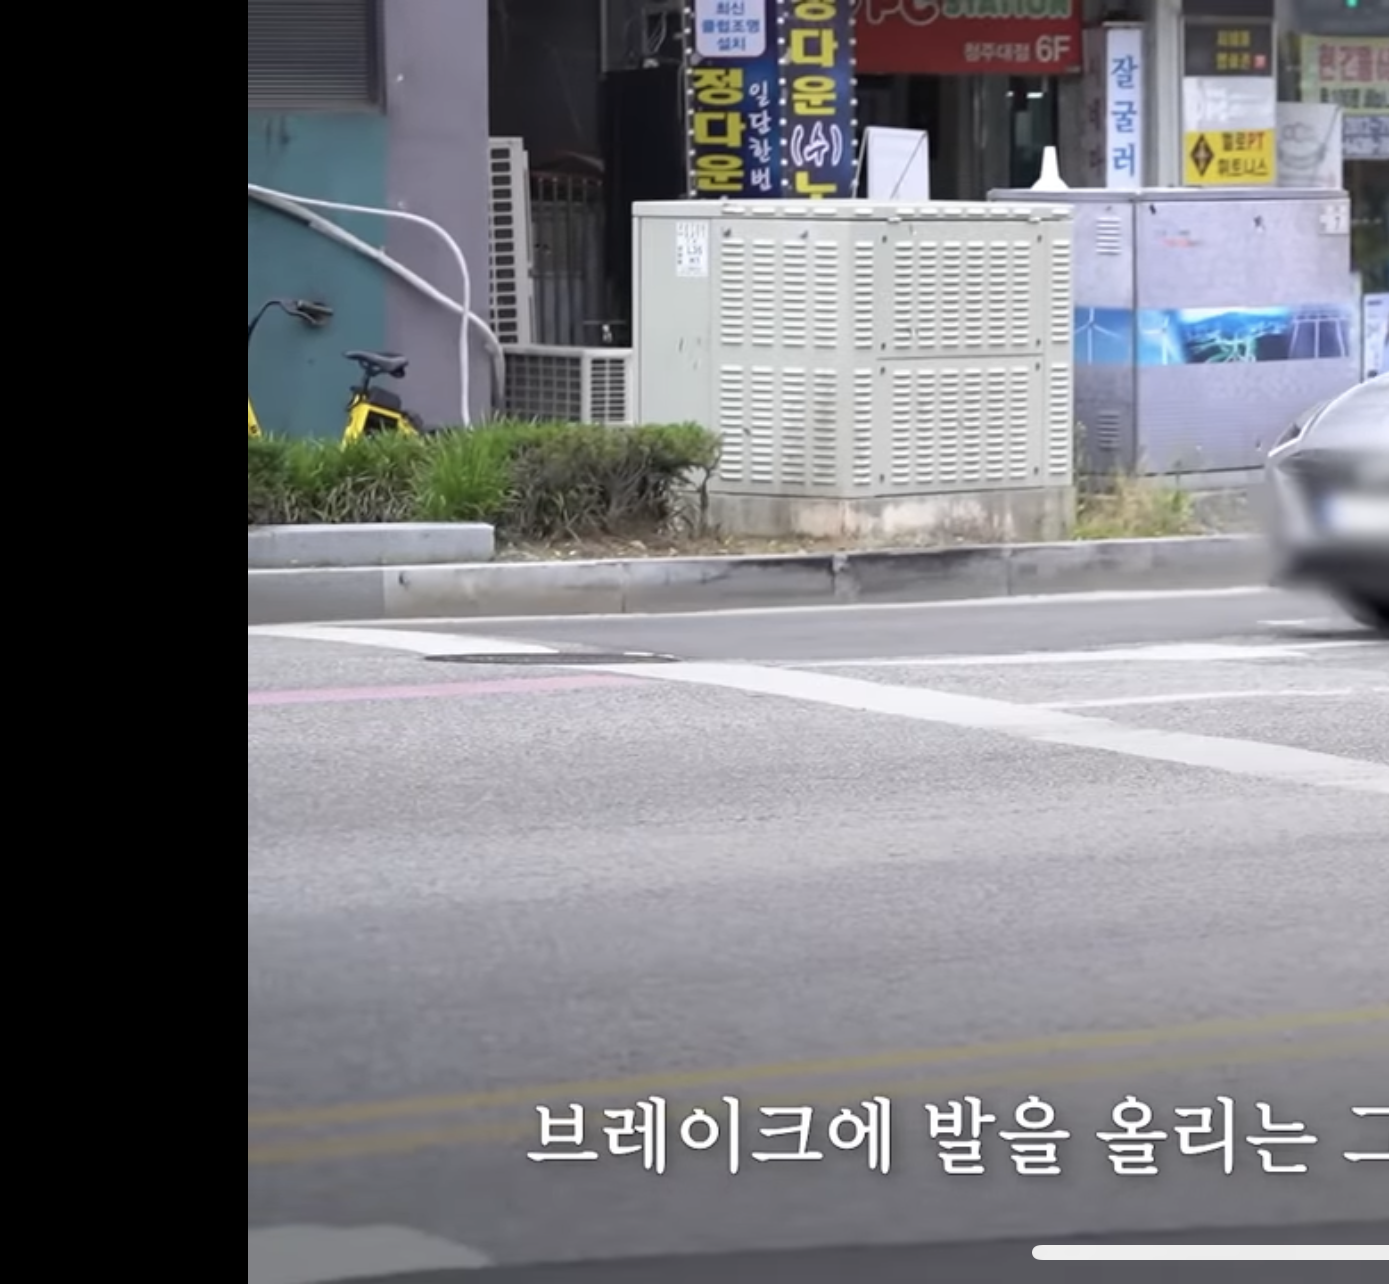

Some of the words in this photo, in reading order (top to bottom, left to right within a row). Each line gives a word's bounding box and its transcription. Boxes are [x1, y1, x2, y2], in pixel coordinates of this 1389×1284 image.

[717, 36, 746, 51] 설치
[1034, 35, 1072, 62] 6F
[693, 68, 747, 191] 정다운
